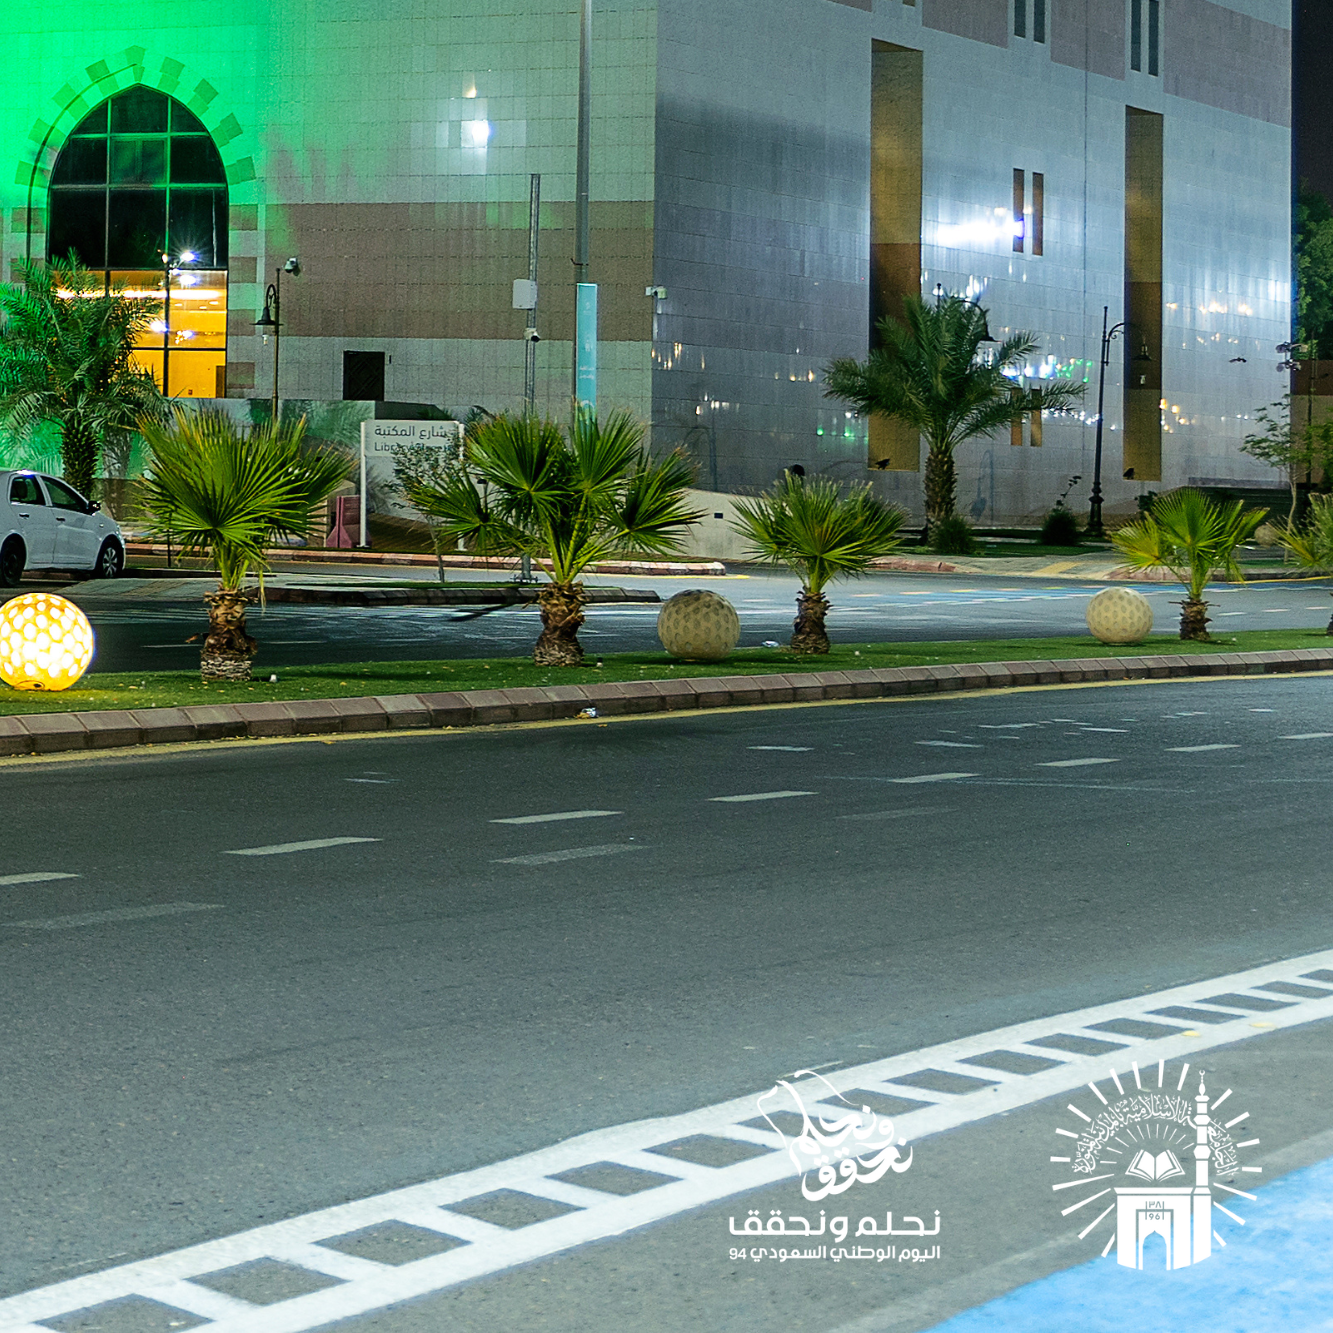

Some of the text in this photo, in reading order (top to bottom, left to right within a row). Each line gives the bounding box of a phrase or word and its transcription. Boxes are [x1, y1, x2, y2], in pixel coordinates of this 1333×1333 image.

[374, 425, 447, 440] شارع المكتبة
[374, 442, 412, 453] Libr
